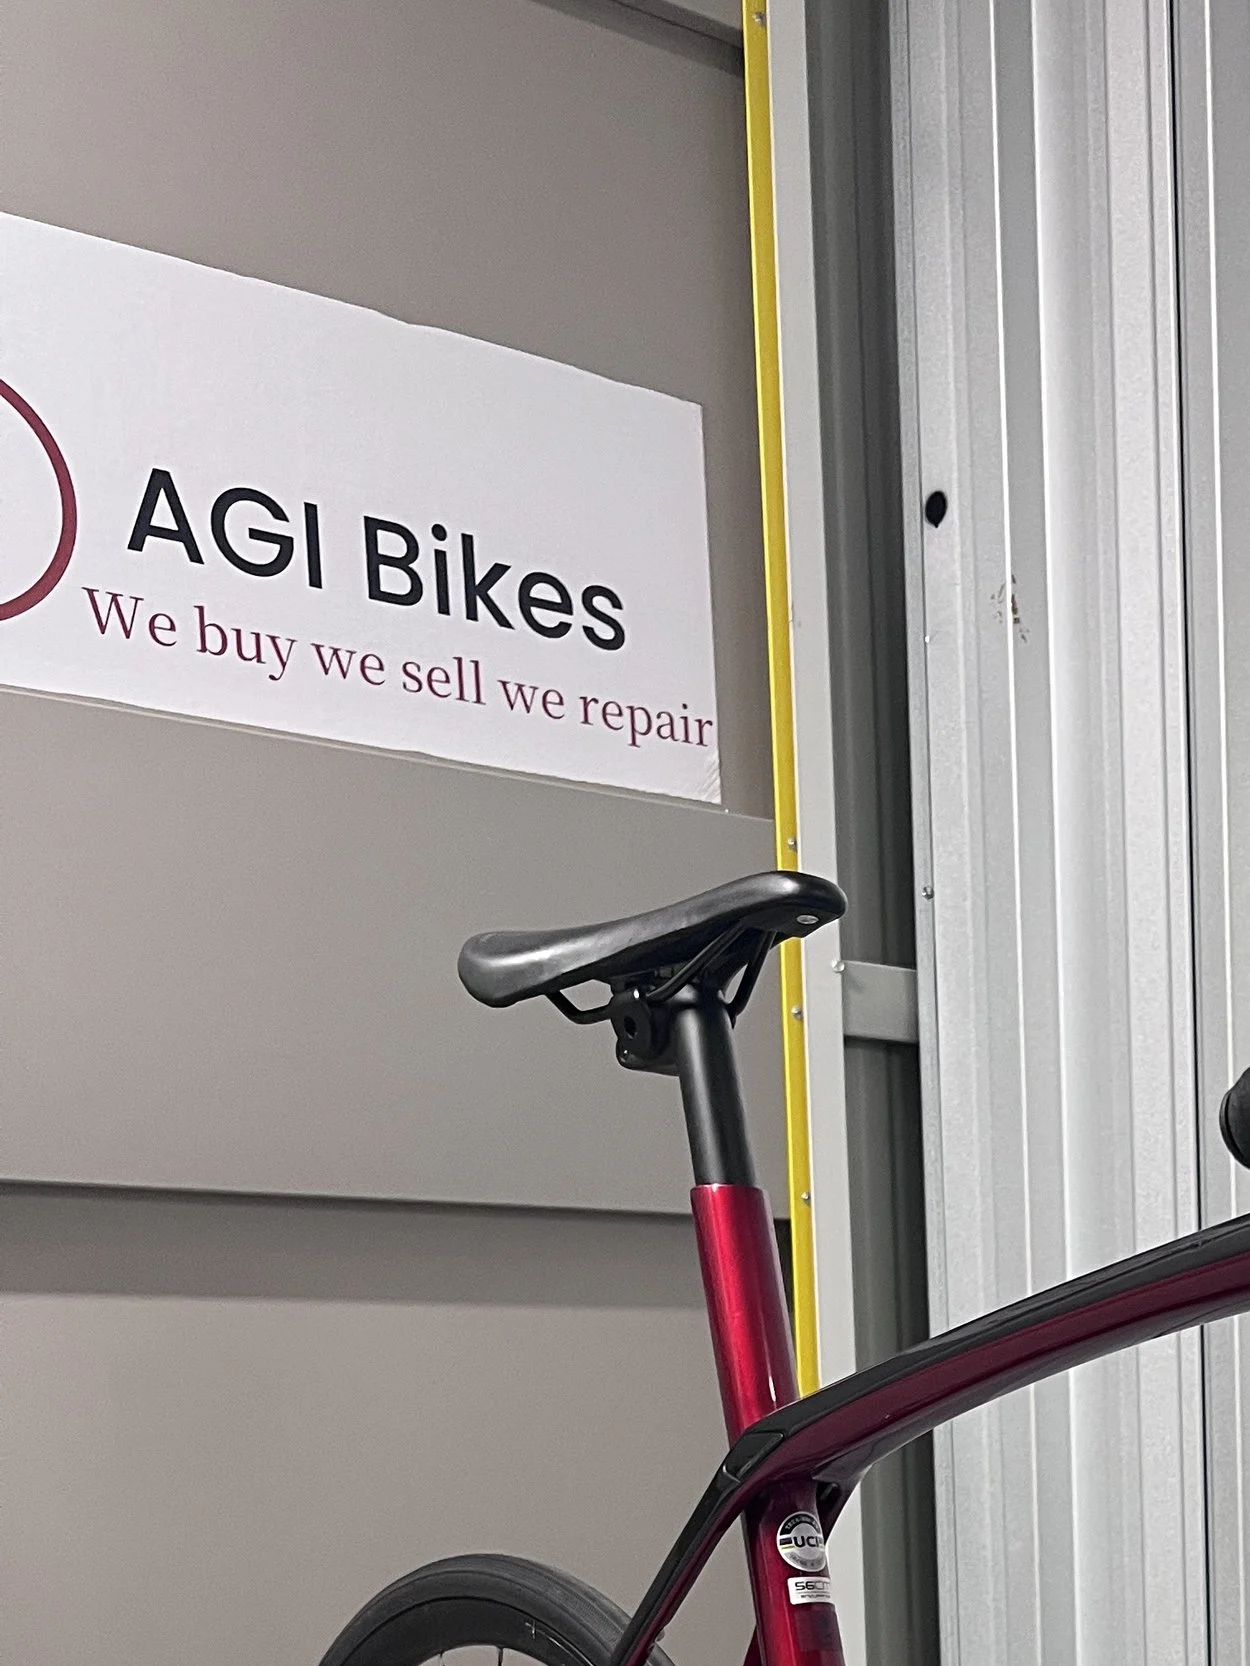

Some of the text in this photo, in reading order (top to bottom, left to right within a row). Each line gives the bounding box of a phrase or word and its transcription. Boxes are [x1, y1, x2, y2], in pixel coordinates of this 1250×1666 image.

[127, 467, 626, 652] AGI Bikes
[82, 586, 714, 748] We buy we sell we repair
[793, 1535, 819, 1548] UCI
